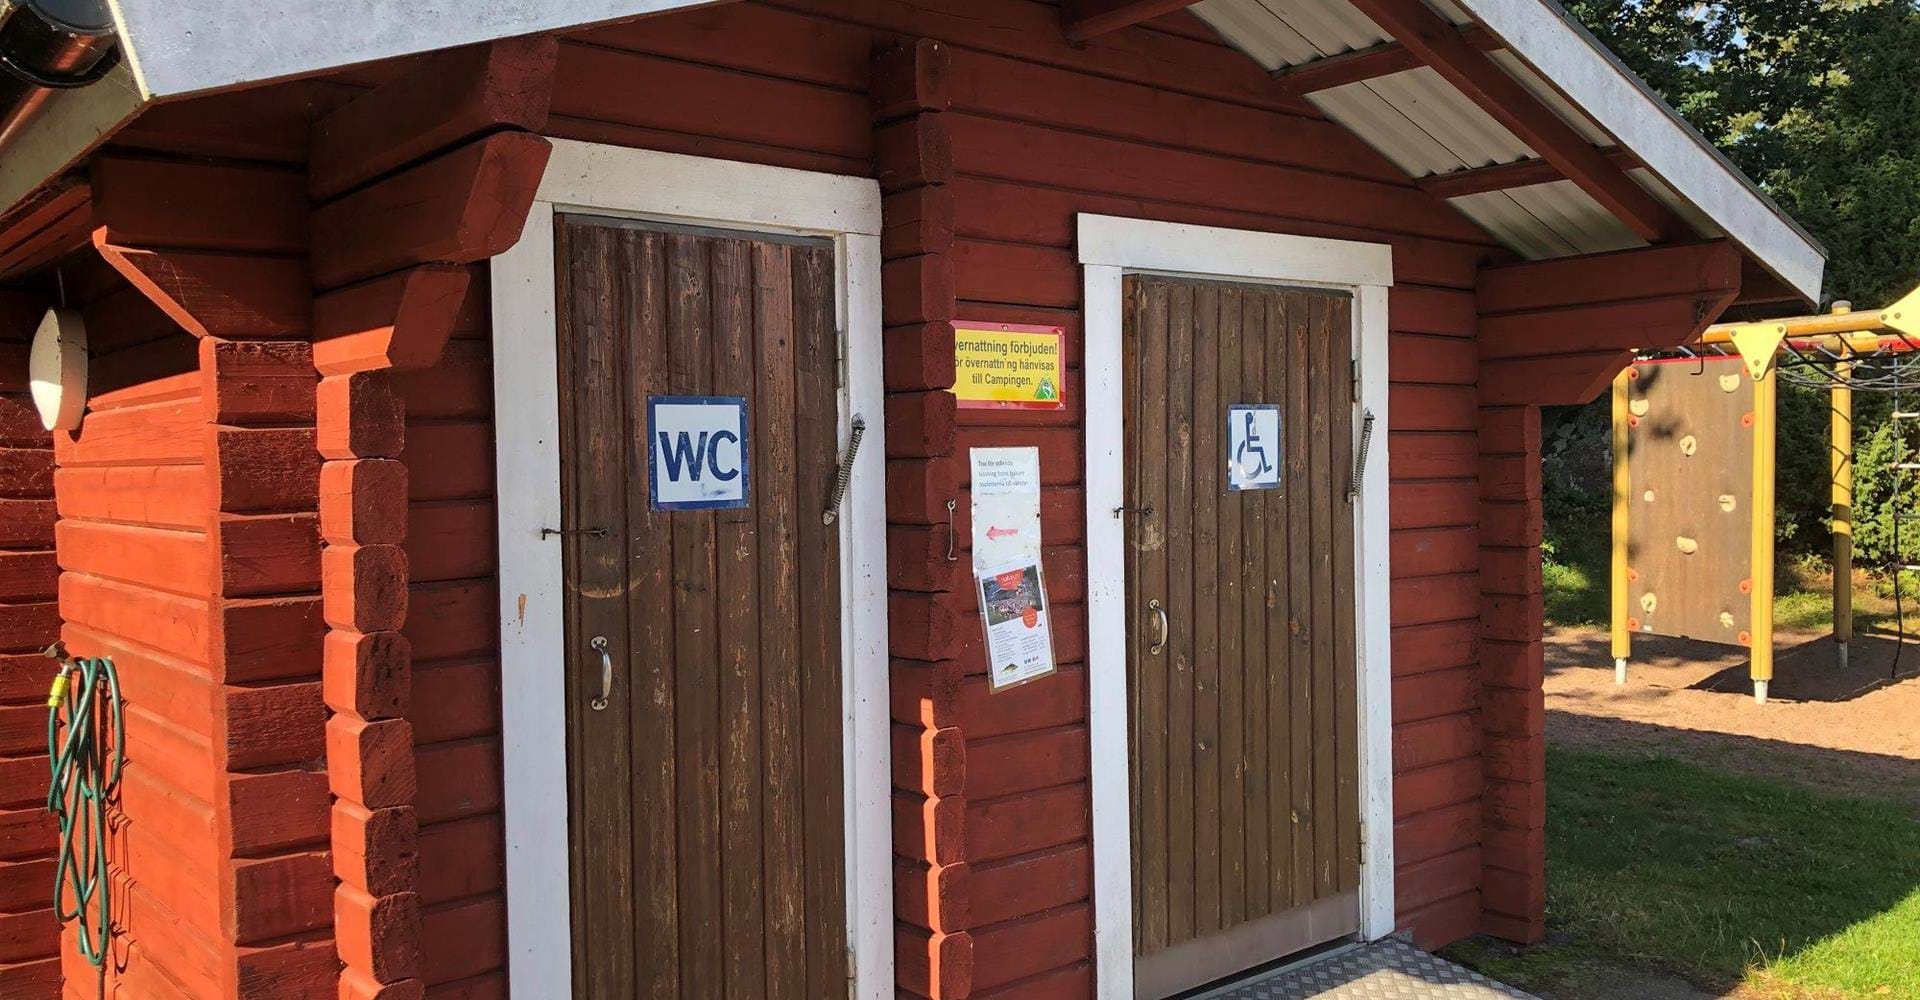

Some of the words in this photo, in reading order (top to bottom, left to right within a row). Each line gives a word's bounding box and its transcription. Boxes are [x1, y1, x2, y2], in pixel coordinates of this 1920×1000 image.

[955, 340, 1007, 356] vernattning
[1010, 340, 1058, 357] förbjuden!
[955, 356, 964, 368] ör
[965, 356, 1018, 372] övernattnng
[1019, 359, 1055, 371] hänvisas
[972, 373, 983, 384] till
[984, 373, 1033, 388] Campingen.
[658, 430, 740, 482] WC
